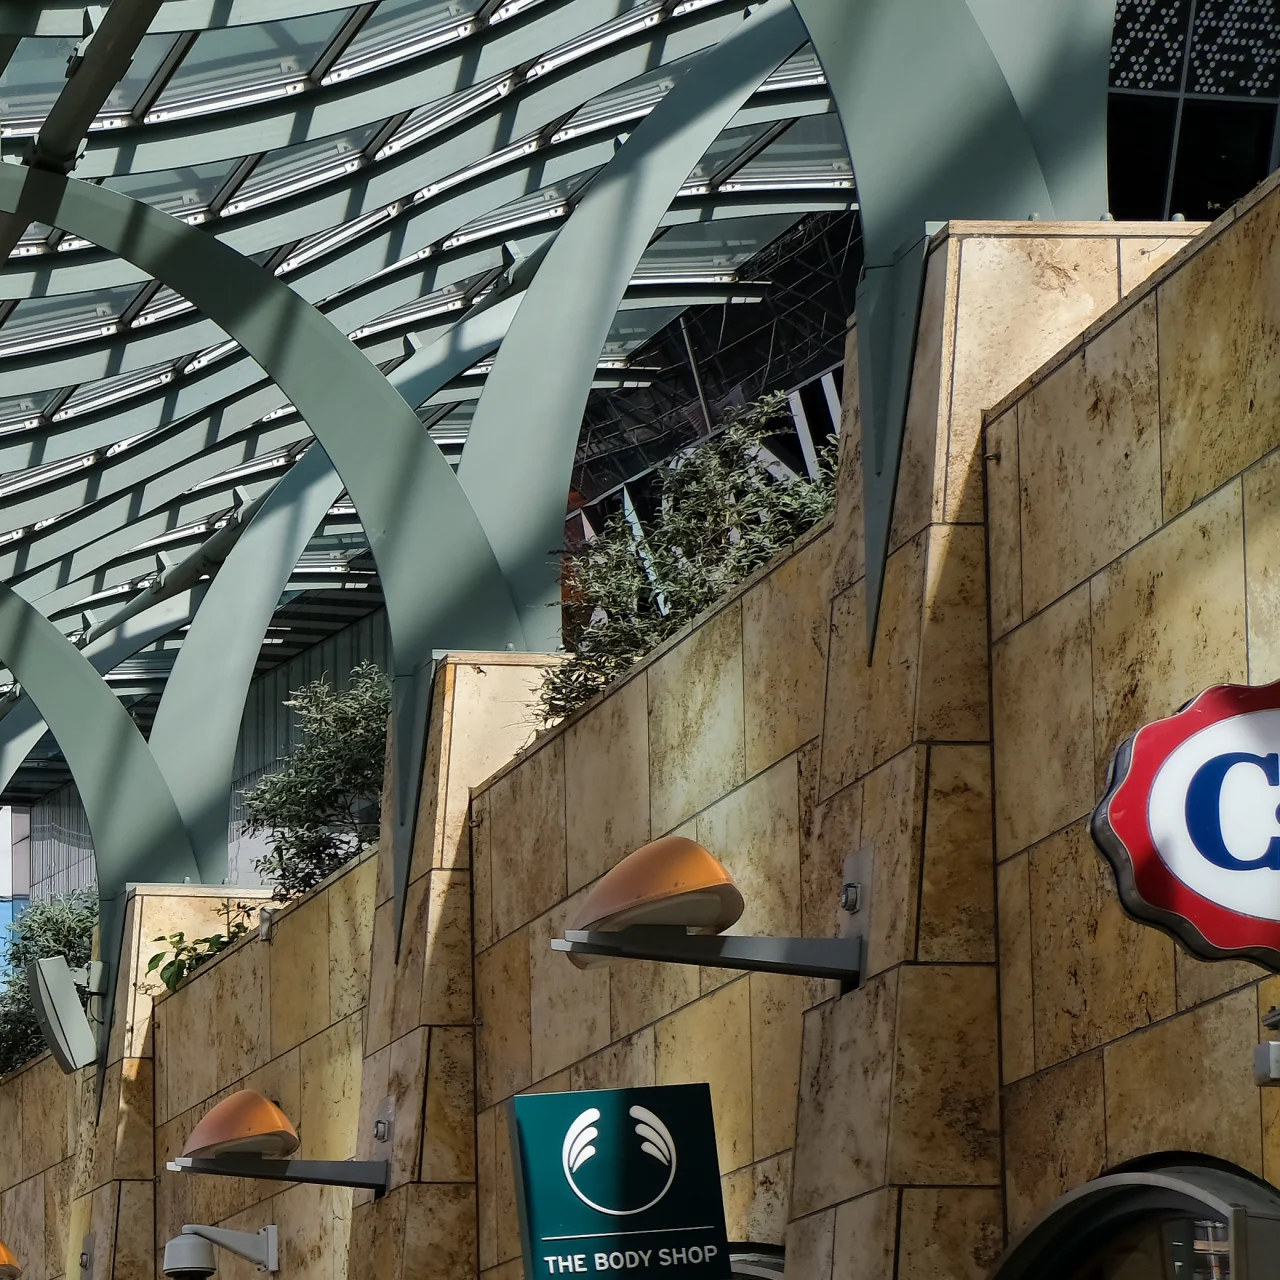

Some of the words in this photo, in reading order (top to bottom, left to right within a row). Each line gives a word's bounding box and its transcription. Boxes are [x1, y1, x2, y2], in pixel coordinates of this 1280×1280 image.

[1185, 751, 1280, 871] C
[543, 1254, 587, 1274] THE
[594, 1250, 653, 1271] BODY
[659, 1245, 718, 1266] SHOP
